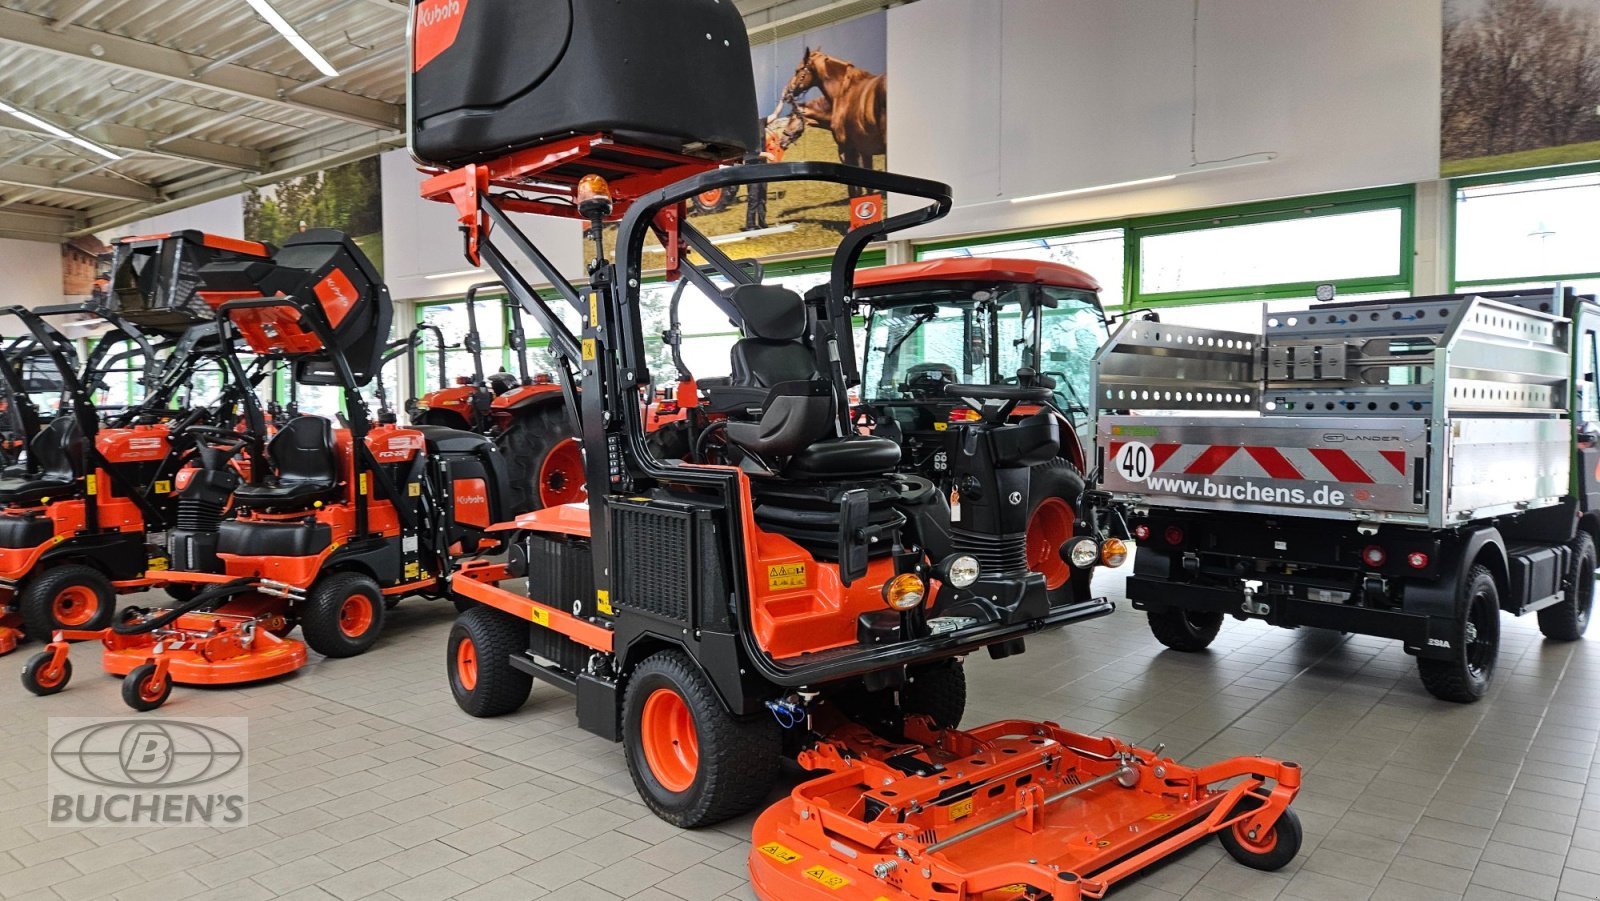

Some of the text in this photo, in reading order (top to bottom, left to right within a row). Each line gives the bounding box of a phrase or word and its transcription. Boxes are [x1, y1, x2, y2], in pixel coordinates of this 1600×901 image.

[418, 0, 459, 27] Kubota
[1123, 446, 1147, 477] 40
[1146, 476, 1345, 506] www.buchens.de
